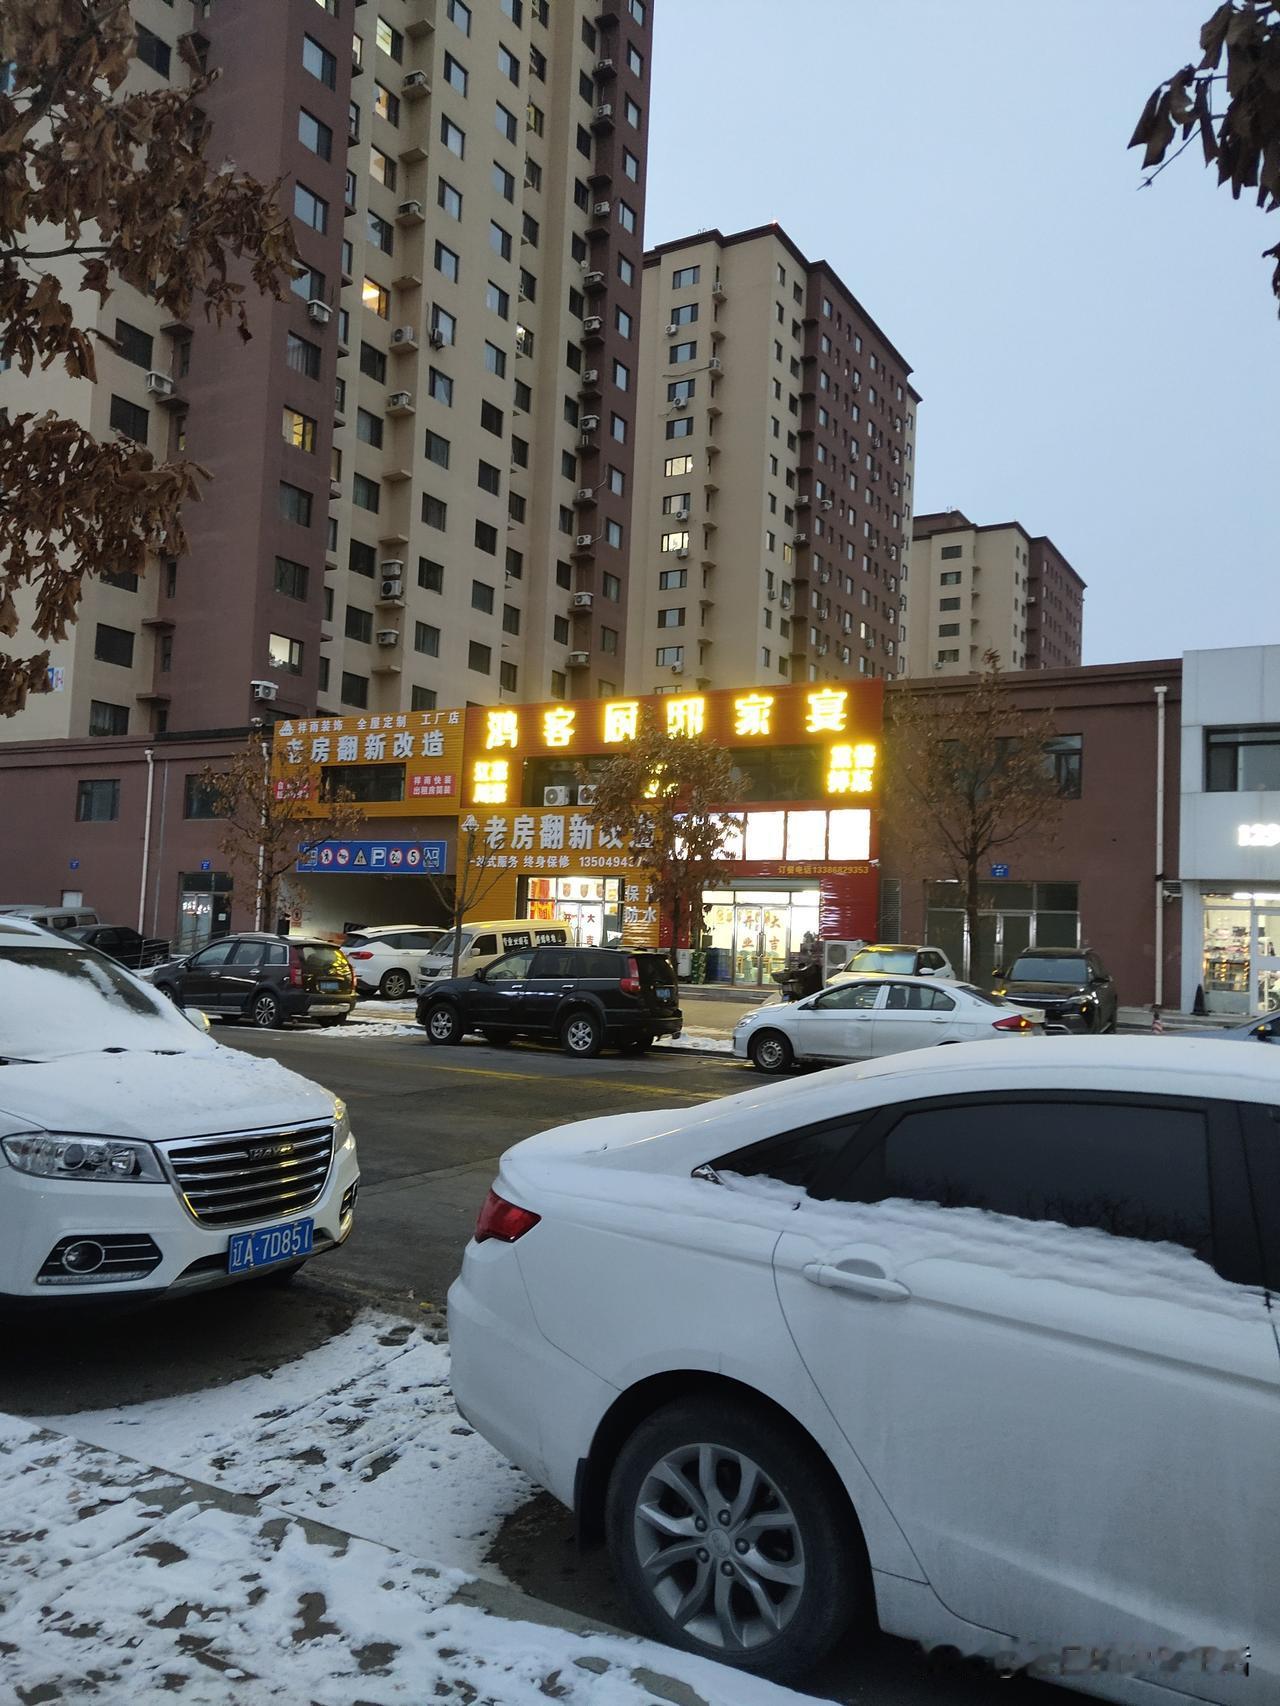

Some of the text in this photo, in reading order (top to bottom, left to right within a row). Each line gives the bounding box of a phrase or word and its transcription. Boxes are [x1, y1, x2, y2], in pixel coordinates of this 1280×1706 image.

[357, 715, 407, 730] 全屋定制
[421, 711, 460, 725] 工厂店
[286, 730, 444, 764] 老房翻新改造
[523, 855, 570, 868] 终身保修
[624, 906, 657, 923] 防水
[249, 1144, 293, 1161] HAV
